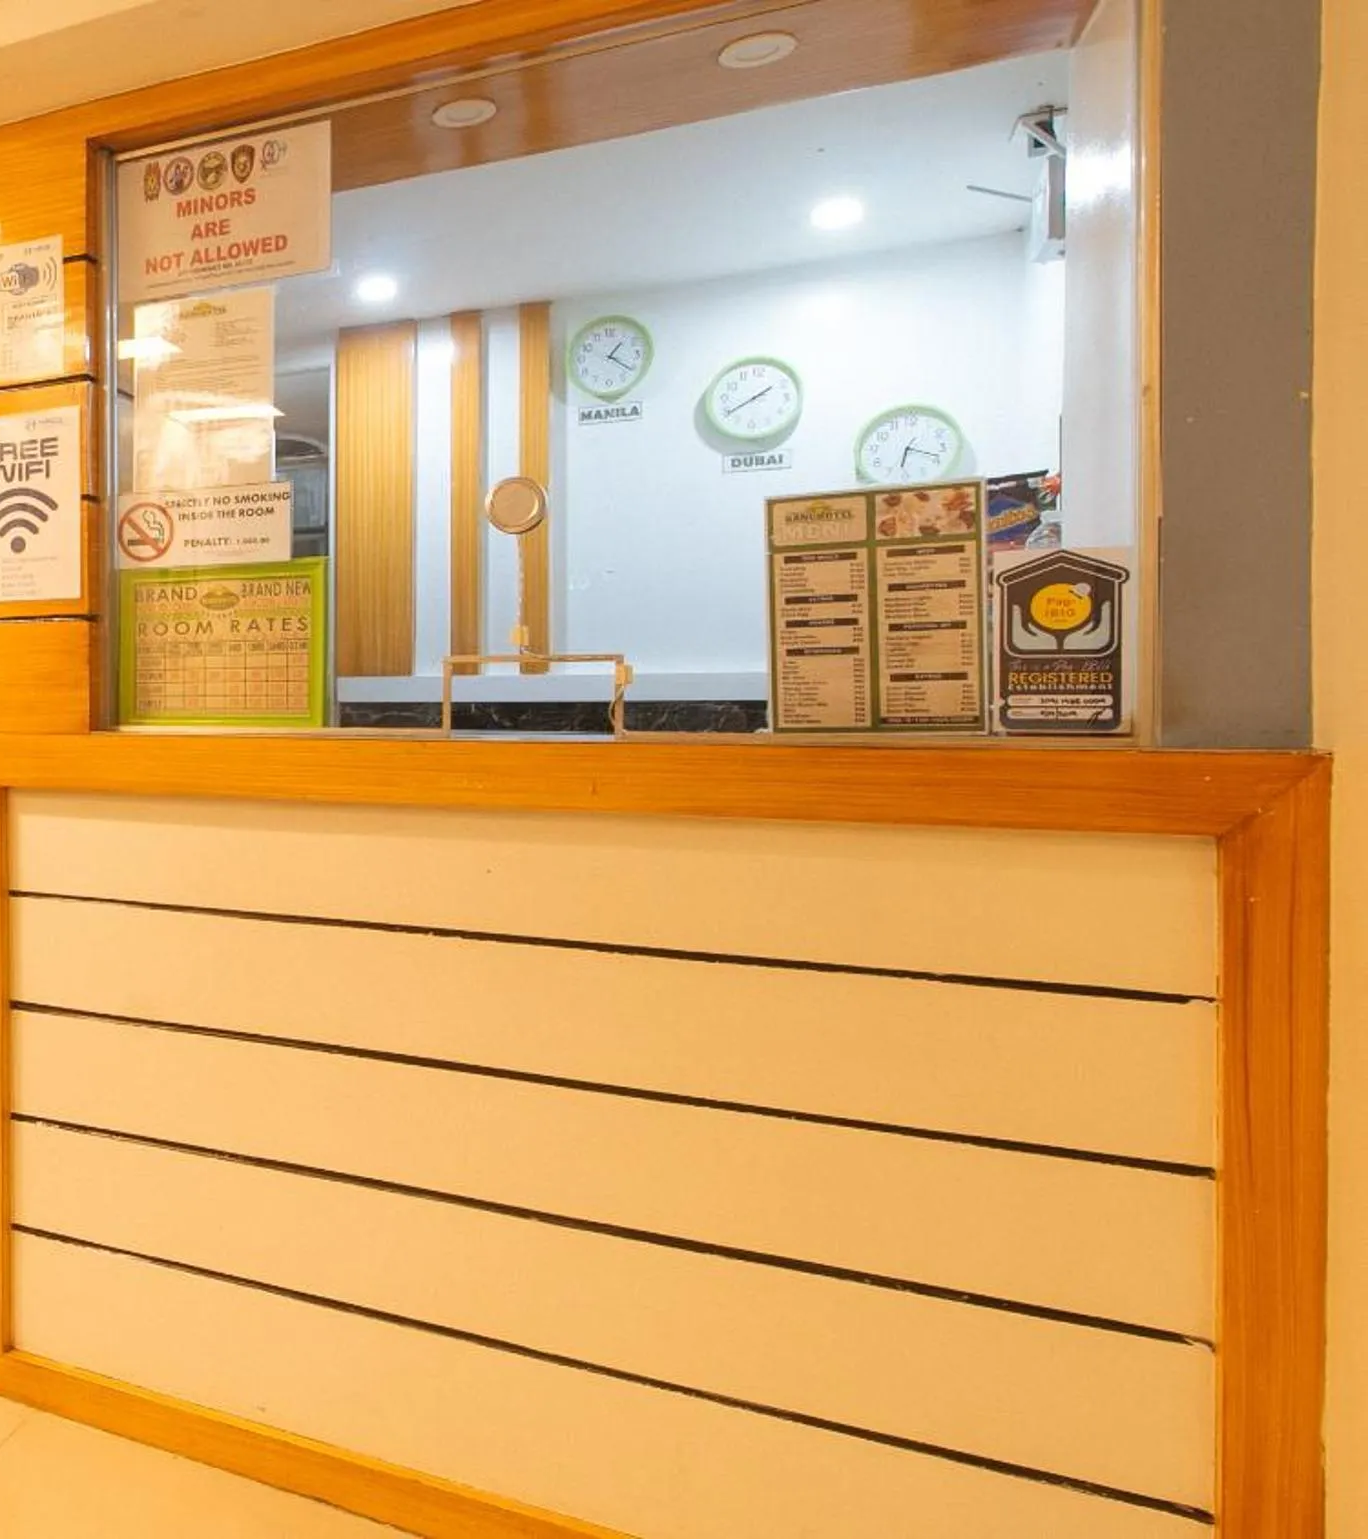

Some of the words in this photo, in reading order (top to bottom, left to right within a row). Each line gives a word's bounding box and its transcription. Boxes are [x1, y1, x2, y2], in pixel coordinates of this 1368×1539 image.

[176, 187, 257, 218] MINORS
[190, 218, 232, 241] ARE
[144, 251, 185, 275] NOT
[189, 234, 289, 267] ALLOWED
[579, 405, 640, 421] MANILA
[730, 453, 784, 468] DUBAI
[212, 495, 231, 506] NO
[234, 491, 290, 504] SMOKING
[178, 511, 214, 521] INSIDE
[216, 510, 235, 519] THE
[238, 506, 275, 518] ROOM
[135, 585, 199, 603] BRAND
[240, 582, 283, 598] BRAND
[138, 621, 214, 638] ROOM
[229, 616, 309, 633] RATES
[1008, 671, 1114, 685] REGISTERED
